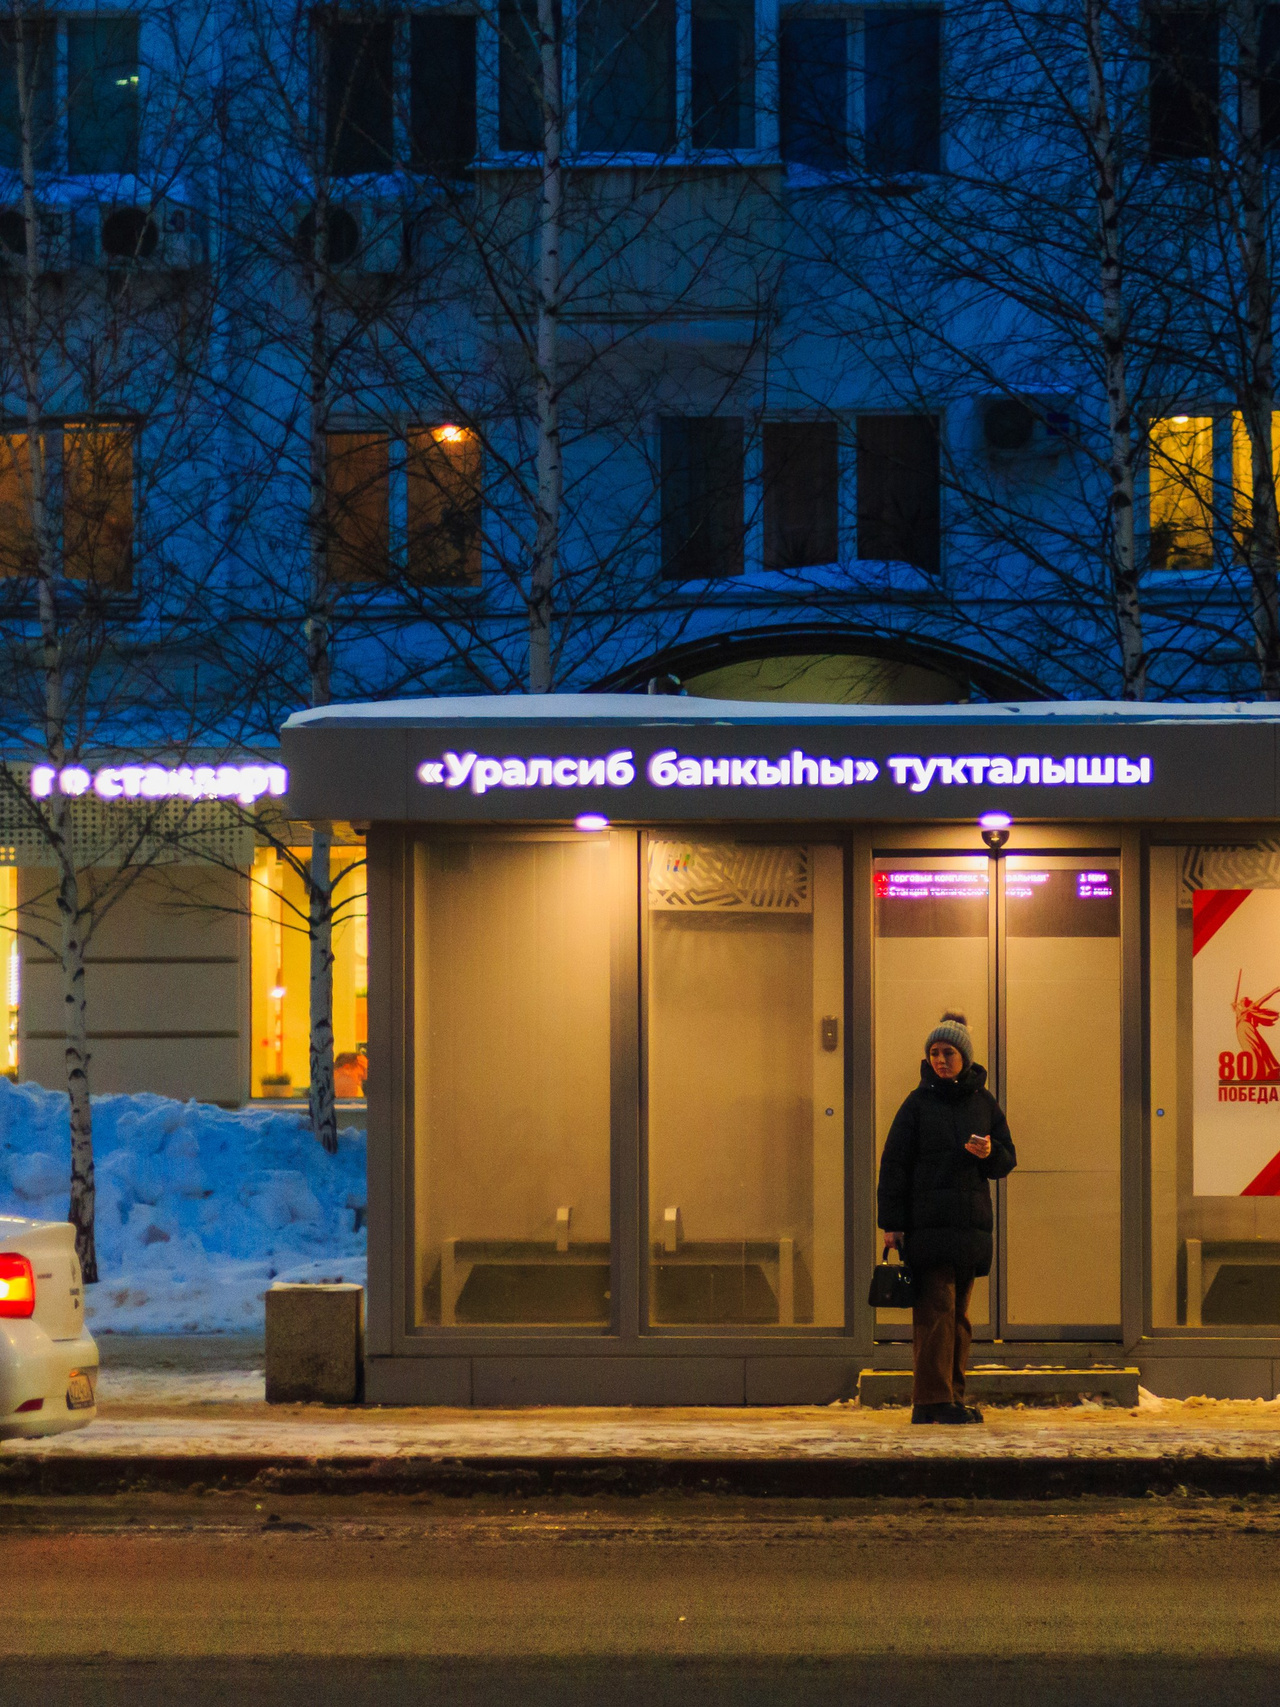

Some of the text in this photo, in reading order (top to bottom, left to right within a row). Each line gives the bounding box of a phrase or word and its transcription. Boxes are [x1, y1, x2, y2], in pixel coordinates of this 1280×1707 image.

[418, 750, 635, 793] «Уралсиб
[650, 750, 879, 786] банкыһы»
[1219, 1051, 1254, 1081] 80
